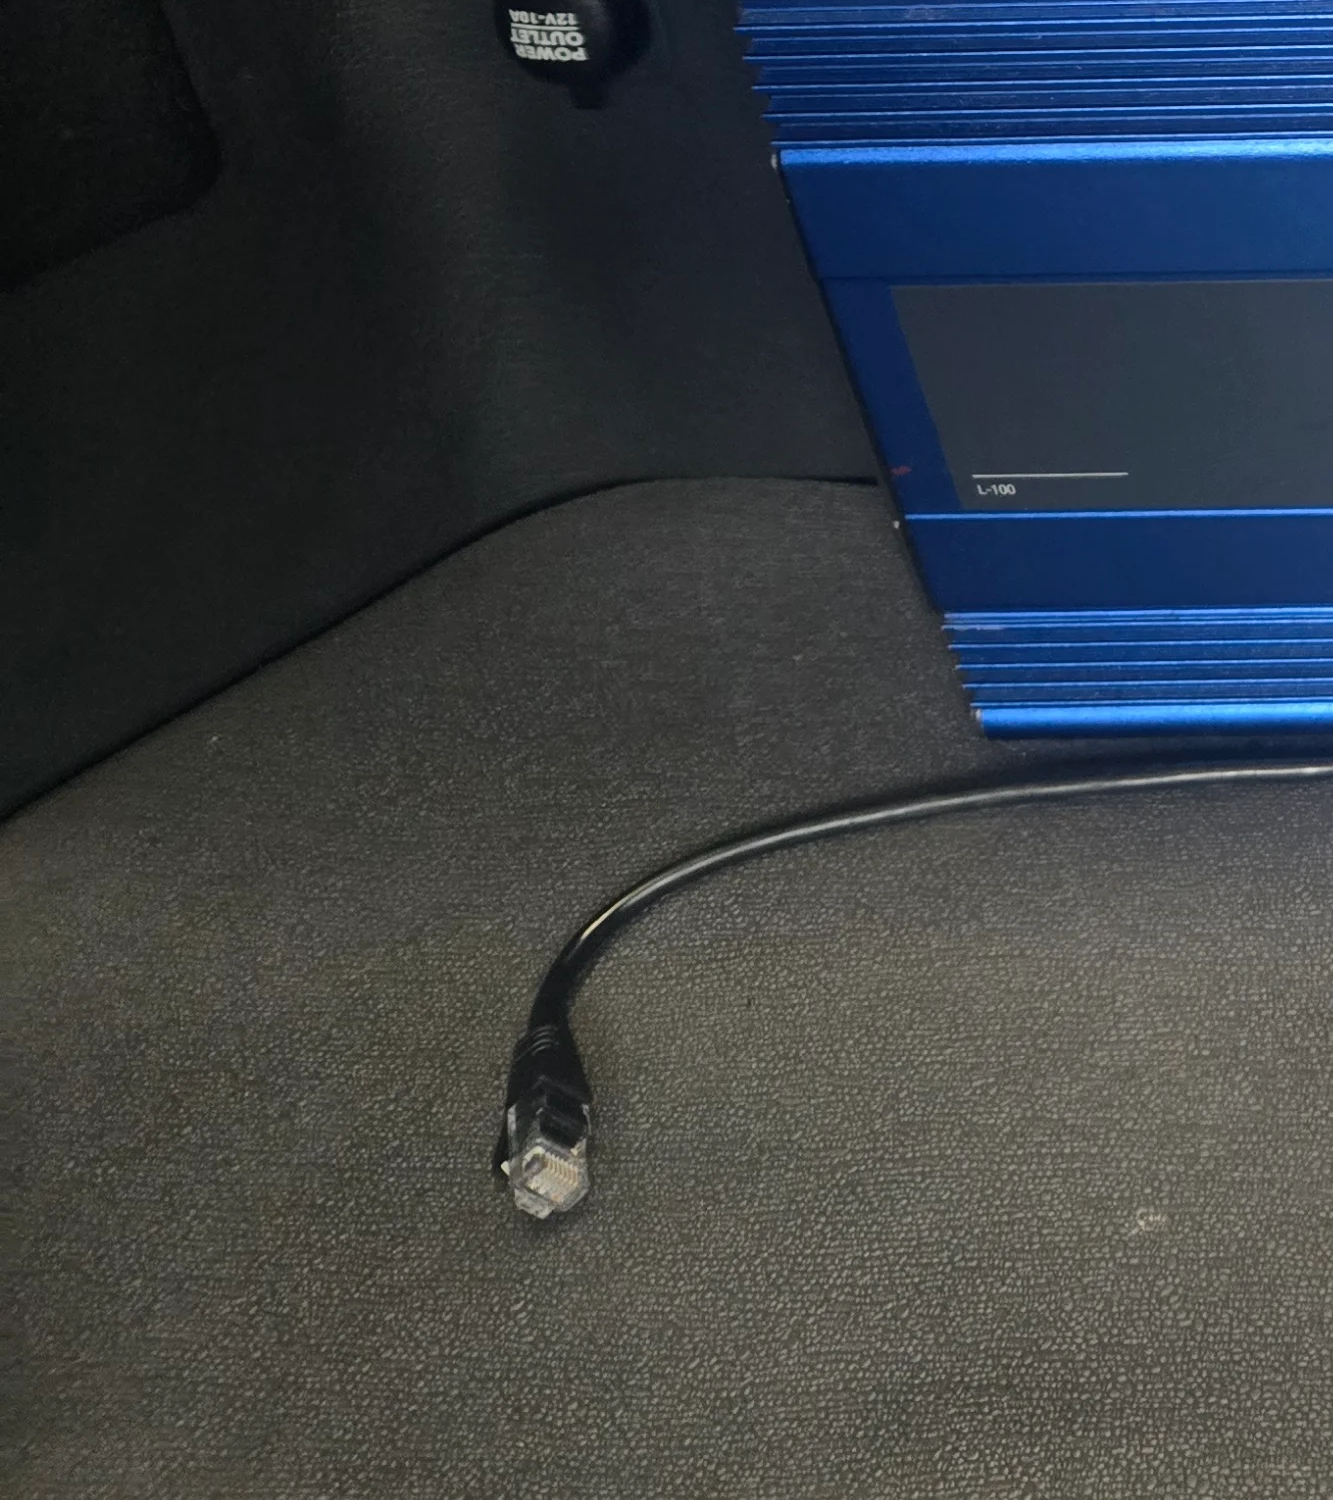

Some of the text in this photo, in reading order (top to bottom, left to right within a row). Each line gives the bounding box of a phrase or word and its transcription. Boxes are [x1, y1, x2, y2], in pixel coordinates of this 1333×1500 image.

[508, 8, 579, 25] 12V-10A
[510, 28, 584, 46] OUTLET
[514, 43, 588, 61] POWER
[977, 484, 1016, 495] L-100
